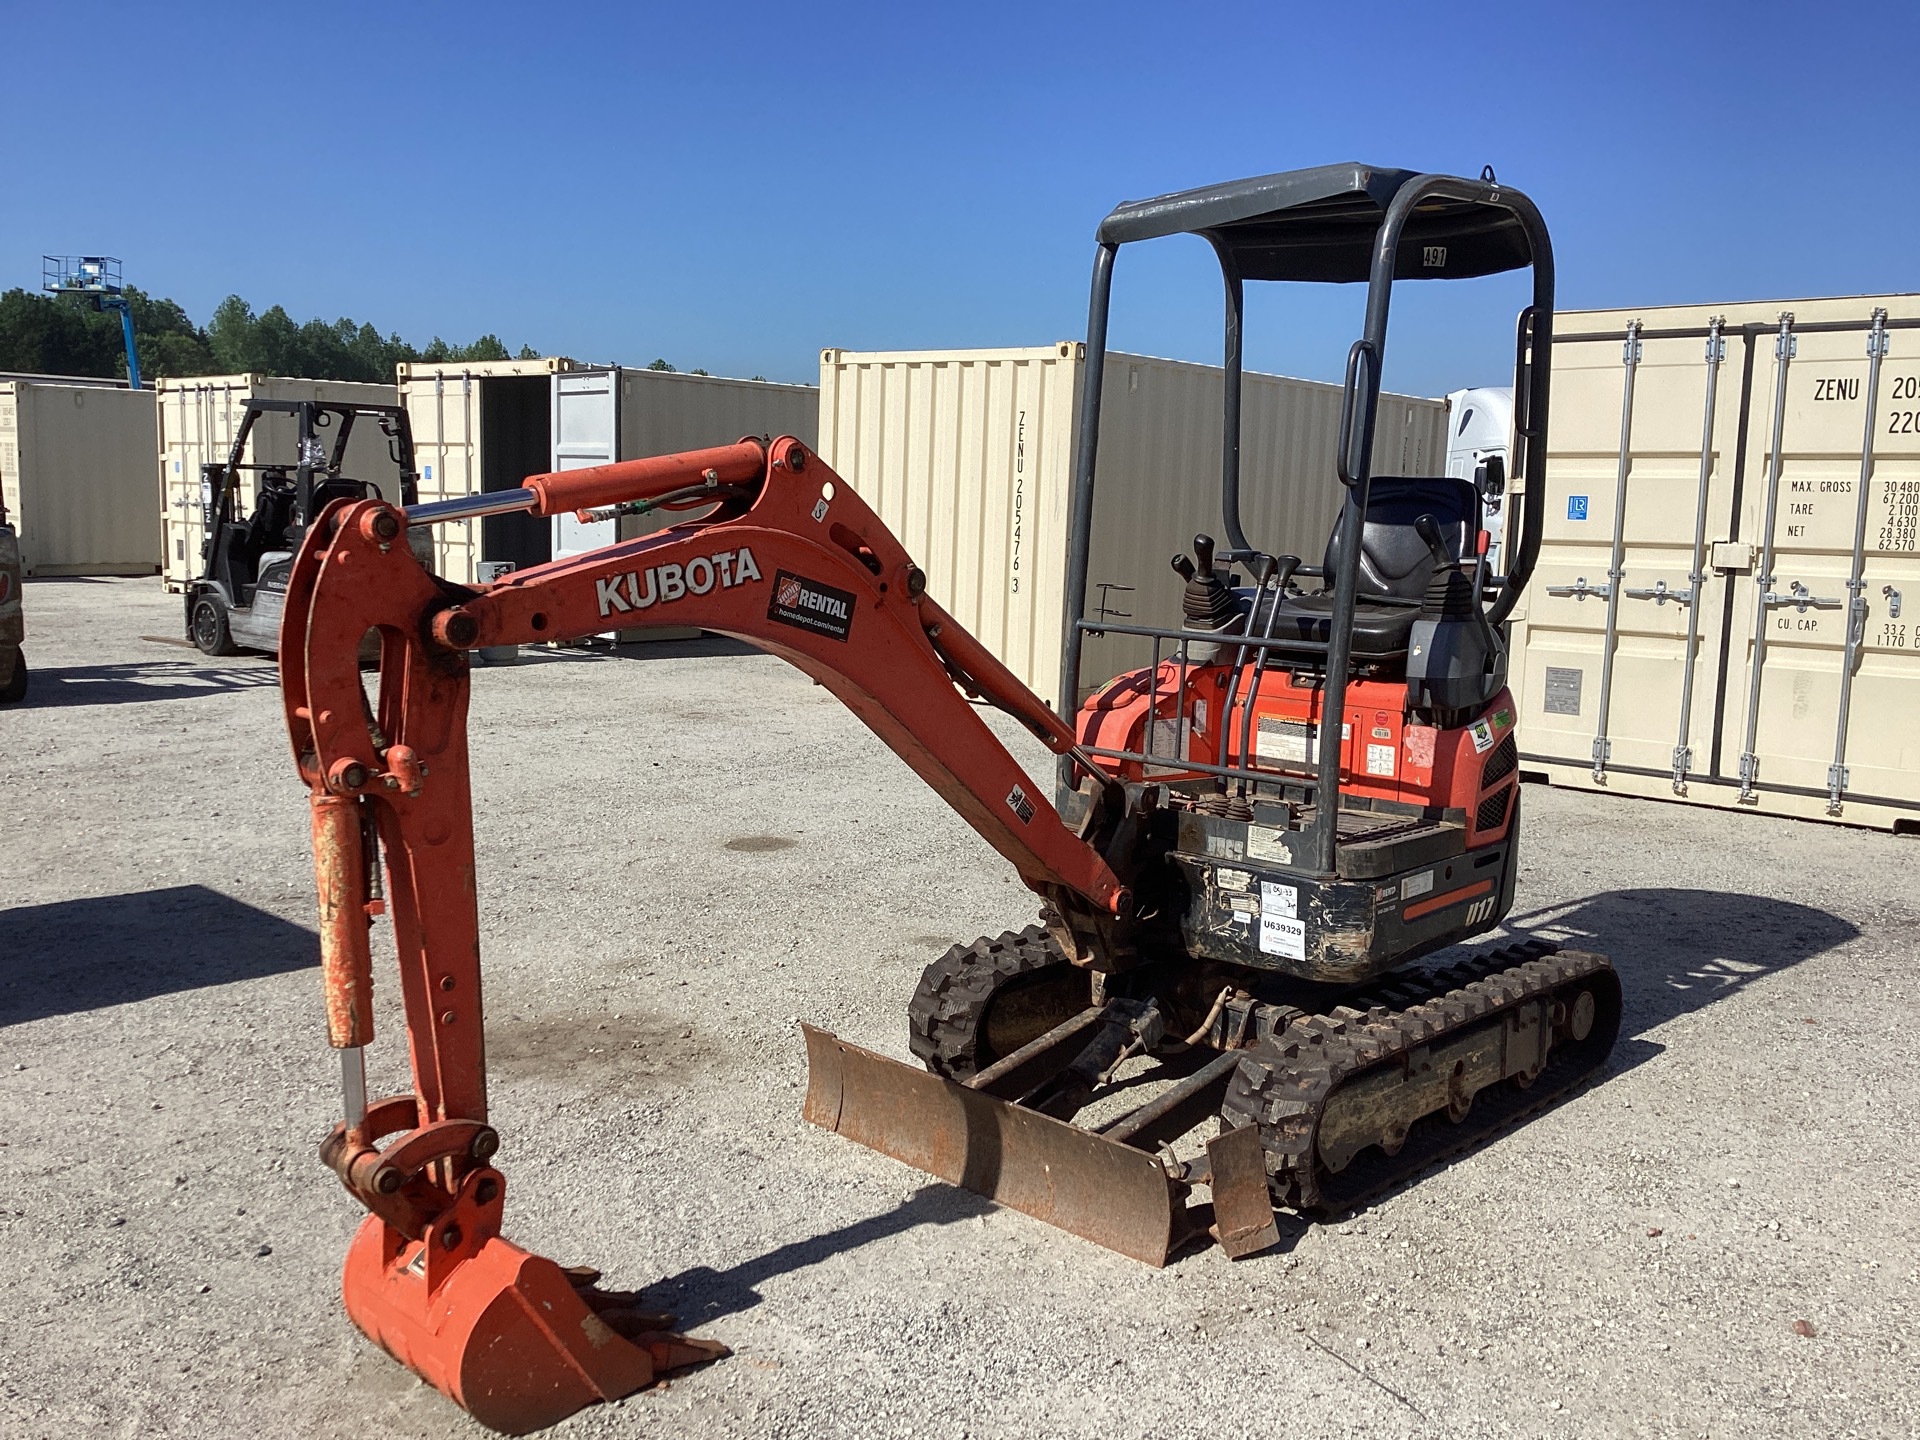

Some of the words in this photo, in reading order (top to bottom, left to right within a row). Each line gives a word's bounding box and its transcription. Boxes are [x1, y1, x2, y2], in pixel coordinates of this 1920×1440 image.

[1425, 248, 1445, 265] 491
[1814, 378, 1859, 400] ZENU
[1892, 377, 1920, 399] 20
[1016, 411, 1026, 473] ZENU
[1791, 481, 1815, 493] MAX.
[1820, 481, 1852, 493] GROSS
[1884, 481, 1919, 493] 30.480
[1883, 493, 1919, 505] 67.200
[1790, 503, 1814, 515] TARE
[1888, 504, 1918, 516] 2.100
[1013, 479, 1023, 571] 205476
[1887, 516, 1917, 528] 4.630
[1787, 526, 1806, 537] NET
[1879, 527, 1916, 540] 28.380
[1878, 539, 1915, 551] 62.570
[595, 547, 763, 617] KUBOTA
[1012, 578, 1019, 593] 3
[798, 588, 848, 620] RENTAL
[778, 607, 845, 635] homedepot.com/rental
[1777, 618, 1793, 630] CU.
[1797, 619, 1819, 632] CAP.
[1883, 623, 1906, 636] 33.2
[1877, 635, 1905, 648] 1.170
[1465, 895, 1495, 927] U17
[1264, 920, 1302, 936] U639329
